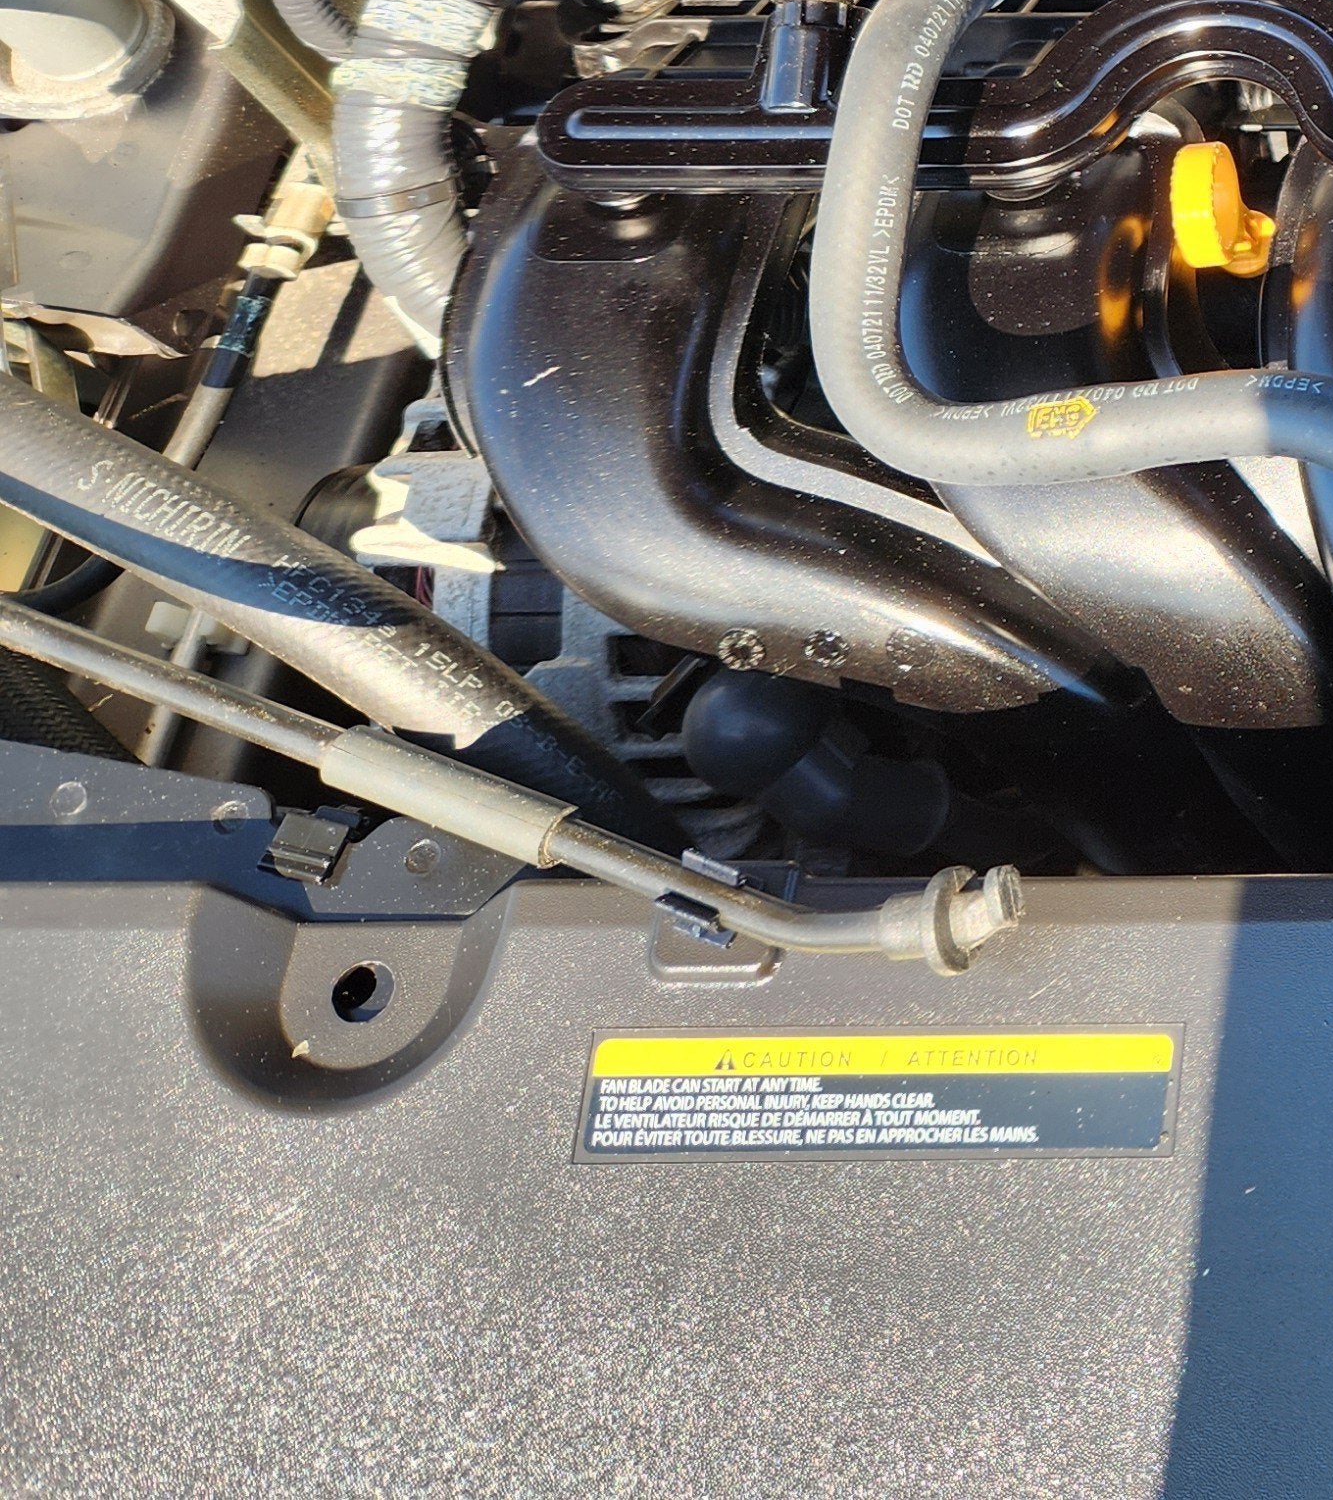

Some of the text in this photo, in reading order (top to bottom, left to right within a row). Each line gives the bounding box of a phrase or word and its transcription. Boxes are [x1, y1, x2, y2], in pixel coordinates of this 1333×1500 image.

[892, 94, 915, 130] DOT
[860, 310, 887, 360] 040721
[1246, 373, 1323, 394] >EPDM<
[743, 1050, 853, 1068] CAUTION
[907, 1049, 1039, 1067] ATTENTION
[600, 1076, 824, 1094] FAN BLADE CAN START AT ANY TIME.
[600, 1092, 936, 1112] TO HELP AVOID PERSONAL INJURY, KEEP HANDS CLEAR.
[595, 1107, 982, 1129] LE VENTILATEUR RISQUE DE DÉMARRER À TOUT MOMENT.
[591, 1126, 1040, 1147] POUR ÉVITER TOUTE BLESSURE, NE PAS EN APPROCHER LES MAINS.
